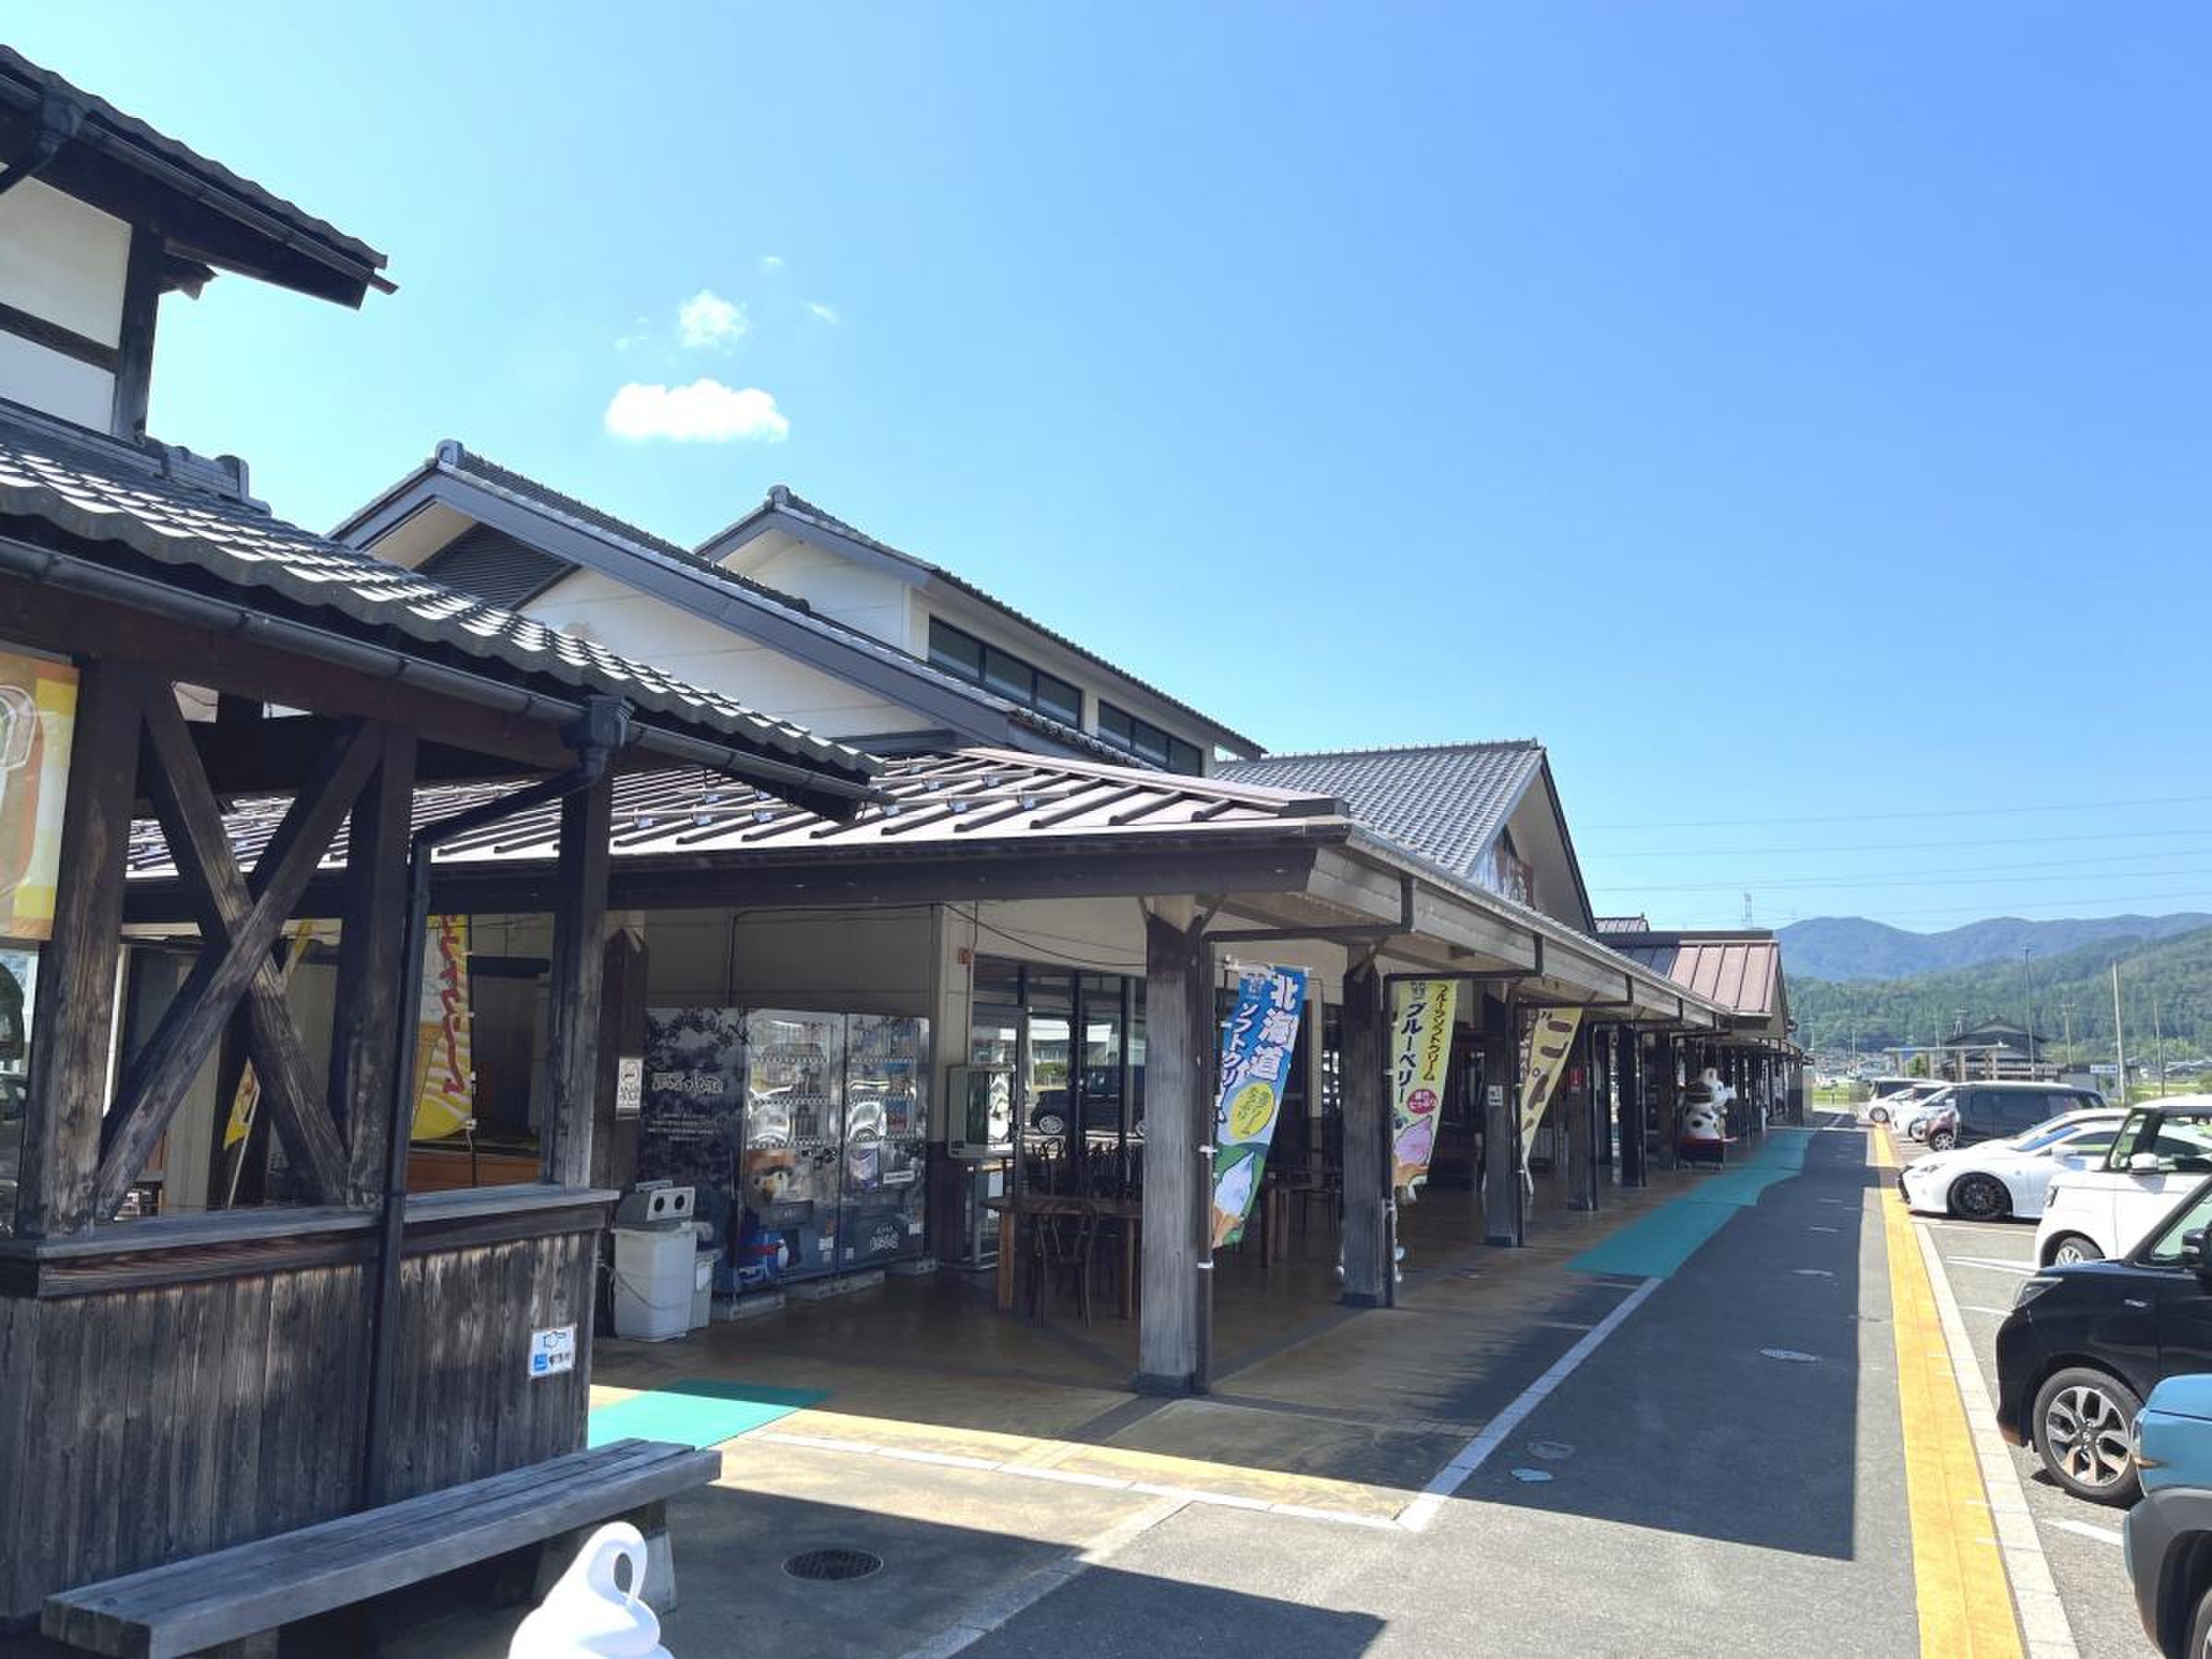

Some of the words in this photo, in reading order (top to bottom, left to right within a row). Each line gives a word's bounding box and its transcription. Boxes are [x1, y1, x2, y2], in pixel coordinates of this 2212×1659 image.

[1240, 973, 1300, 1080] 北海道
[1400, 1002, 1428, 1103] ブルーベリー
